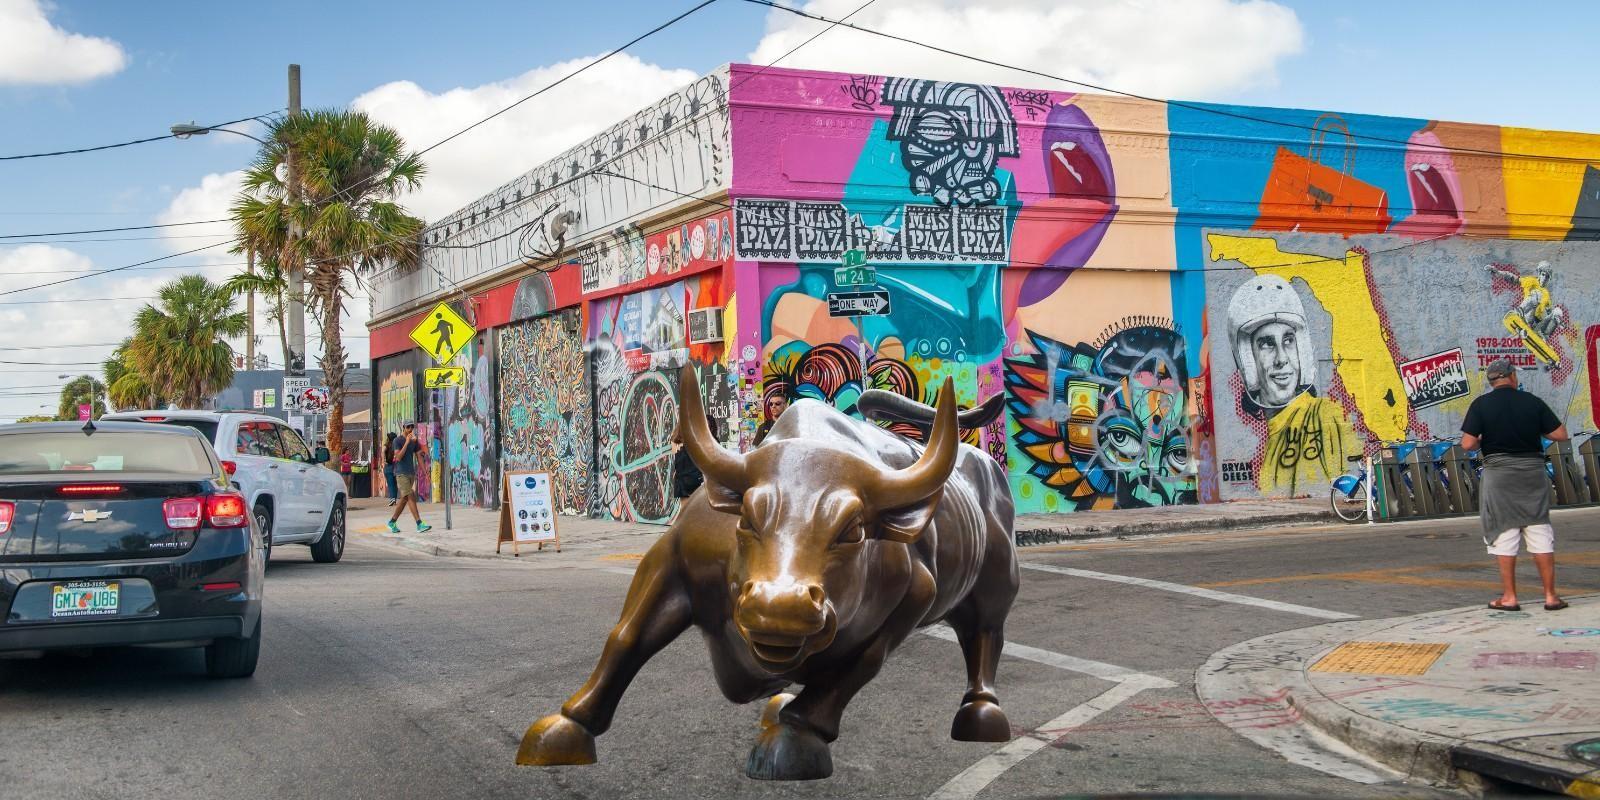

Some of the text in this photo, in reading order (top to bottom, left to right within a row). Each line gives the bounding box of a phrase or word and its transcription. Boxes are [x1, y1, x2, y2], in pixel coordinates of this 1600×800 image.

[740, 206, 786, 226] MAS
[798, 208, 843, 228] MAS
[909, 212, 950, 230] MAS
[961, 213, 1000, 231] MAS
[740, 226, 788, 249] PAZ
[798, 227, 844, 251] PAZ
[909, 230, 950, 252] PAZ
[961, 230, 1002, 253] PAZ
[583, 261, 599, 284] PAZ
[837, 273, 847, 284] NW
[850, 270, 864, 284] 24
[839, 299, 856, 310] ONE
[862, 298, 879, 308] WAY
[1476, 337, 1523, 348] 1978-2018
[1438, 382, 1462, 396] USA
[1222, 462, 1253, 472] BRYAN
[1222, 471, 1254, 481] DEESE
[55, 592, 77, 609] GMI
[52, 609, 117, 618] OceanAutoSales.com
